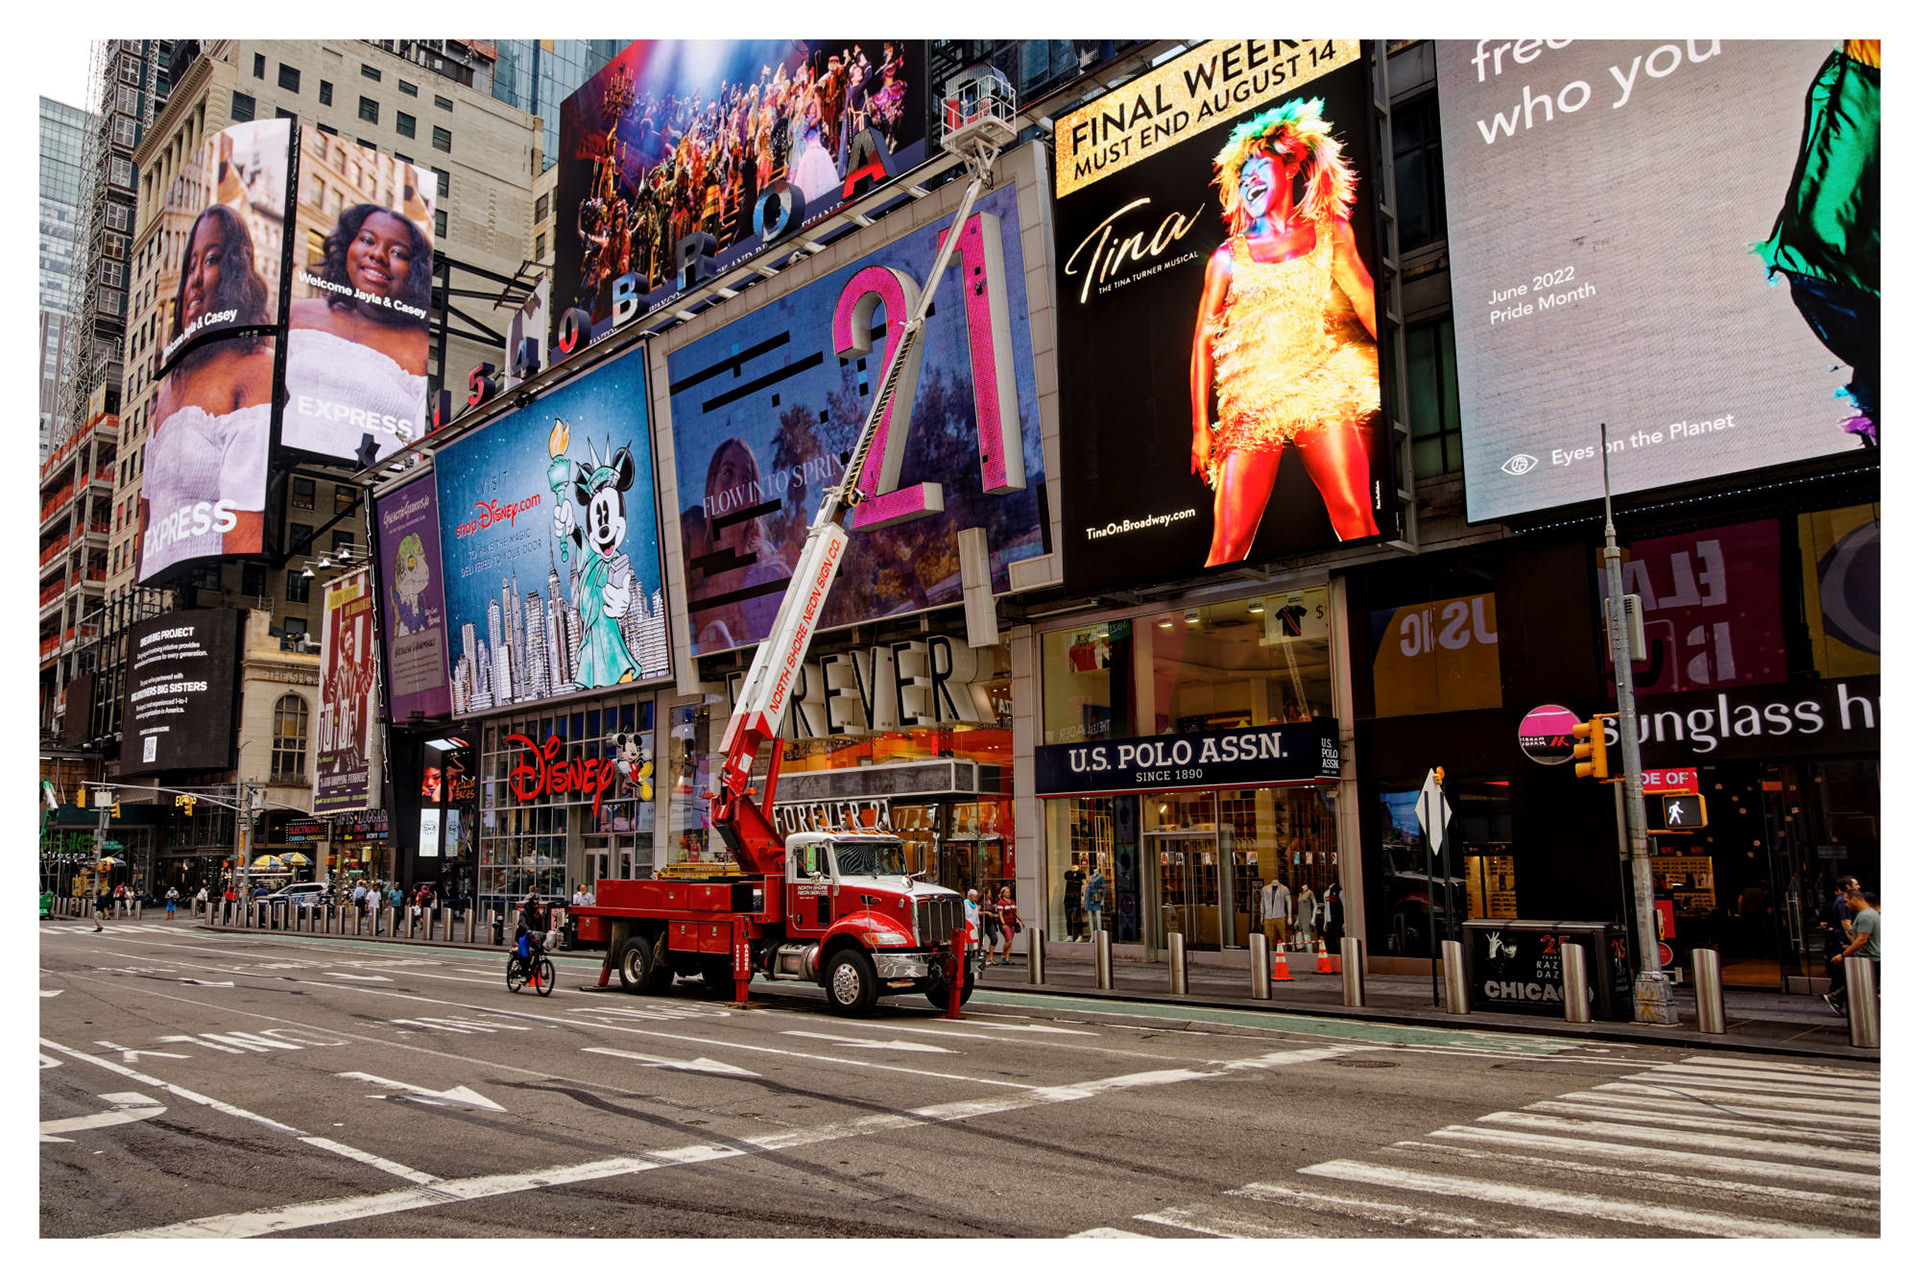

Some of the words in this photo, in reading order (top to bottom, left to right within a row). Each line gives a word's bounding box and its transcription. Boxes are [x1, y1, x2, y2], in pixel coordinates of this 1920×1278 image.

[1072, 83, 1173, 156] FINAL
[1184, 40, 1309, 98] WEEK
[1476, 80, 1592, 144] who
[1609, 40, 1722, 109] you
[1074, 137, 1133, 181] MUST
[1140, 110, 1189, 150] END
[1197, 55, 1301, 122] AUGUST
[1308, 46, 1336, 69] 14
[1065, 197, 1205, 304] Tina
[1098, 284, 1113, 295] THE
[1114, 277, 1131, 289] TINA
[1133, 266, 1163, 283] TURNER
[1164, 250, 1199, 273] MUSICAL
[1488, 280, 1528, 305] June
[1533, 265, 1575, 292] 2022
[298, 271, 352, 296] Welcome
[354, 288, 382, 305] Jayla
[382, 296, 392, 309] &
[393, 299, 427, 319] Casey
[1490, 300, 1533, 325] Pride
[1538, 283, 1596, 311] Month
[204, 309, 237, 326] Casey
[833, 209, 1024, 531] 21
[297, 397, 413, 439] EXPRESS
[1552, 447, 1594, 468] Eyes
[1602, 441, 1625, 453] on
[1630, 427, 1664, 449] the
[1670, 413, 1735, 441] Planet
[480, 470, 508, 495] VISIT
[703, 482, 753, 518] FLOW
[749, 472, 789, 501] INTO
[792, 445, 856, 488] SPRIN
[143, 498, 238, 560] EXPRESS
[479, 542, 494, 556] HAVE
[496, 537, 507, 549] THE
[510, 528, 531, 542] MAGIC
[1086, 508, 1196, 540] TinaOnBroadway.com
[461, 559, 492, 577] DELIVERED
[504, 548, 520, 560] YOUR
[523, 538, 543, 554] DOOR
[161, 626, 195, 640] PROJECT
[769, 667, 792, 714] NORTH
[787, 624, 808, 669] SHORE
[803, 587, 822, 625] NEON
[816, 557, 834, 590] SIGN
[829, 537, 842, 559] CO.
[157, 684, 168, 695] BIG
[169, 681, 208, 693] SISTERS
[726, 635, 975, 740] FREVER
[1603, 693, 1824, 753] sunglass
[1837, 683, 1880, 730] h
[1069, 748, 1112, 772] U.S.
[1118, 739, 1193, 770] POLO
[1198, 732, 1288, 764] ASSN.
[1321, 738, 1333, 748] U.S.
[1321, 748, 1339, 759] POLO
[1136, 770, 1171, 782] SINCE
[1175, 768, 1203, 781] 1890
[1641, 772, 1661, 785] DE
[1666, 773, 1689, 785] OF
[335, 812, 354, 825] GIFTS
[772, 800, 863, 836] FOREVER
[870, 799, 893, 831] 21
[1536, 961, 1563, 970] RAZ
[1536, 971, 1560, 979] DAZ
[1484, 979, 1594, 1002] CHICA
